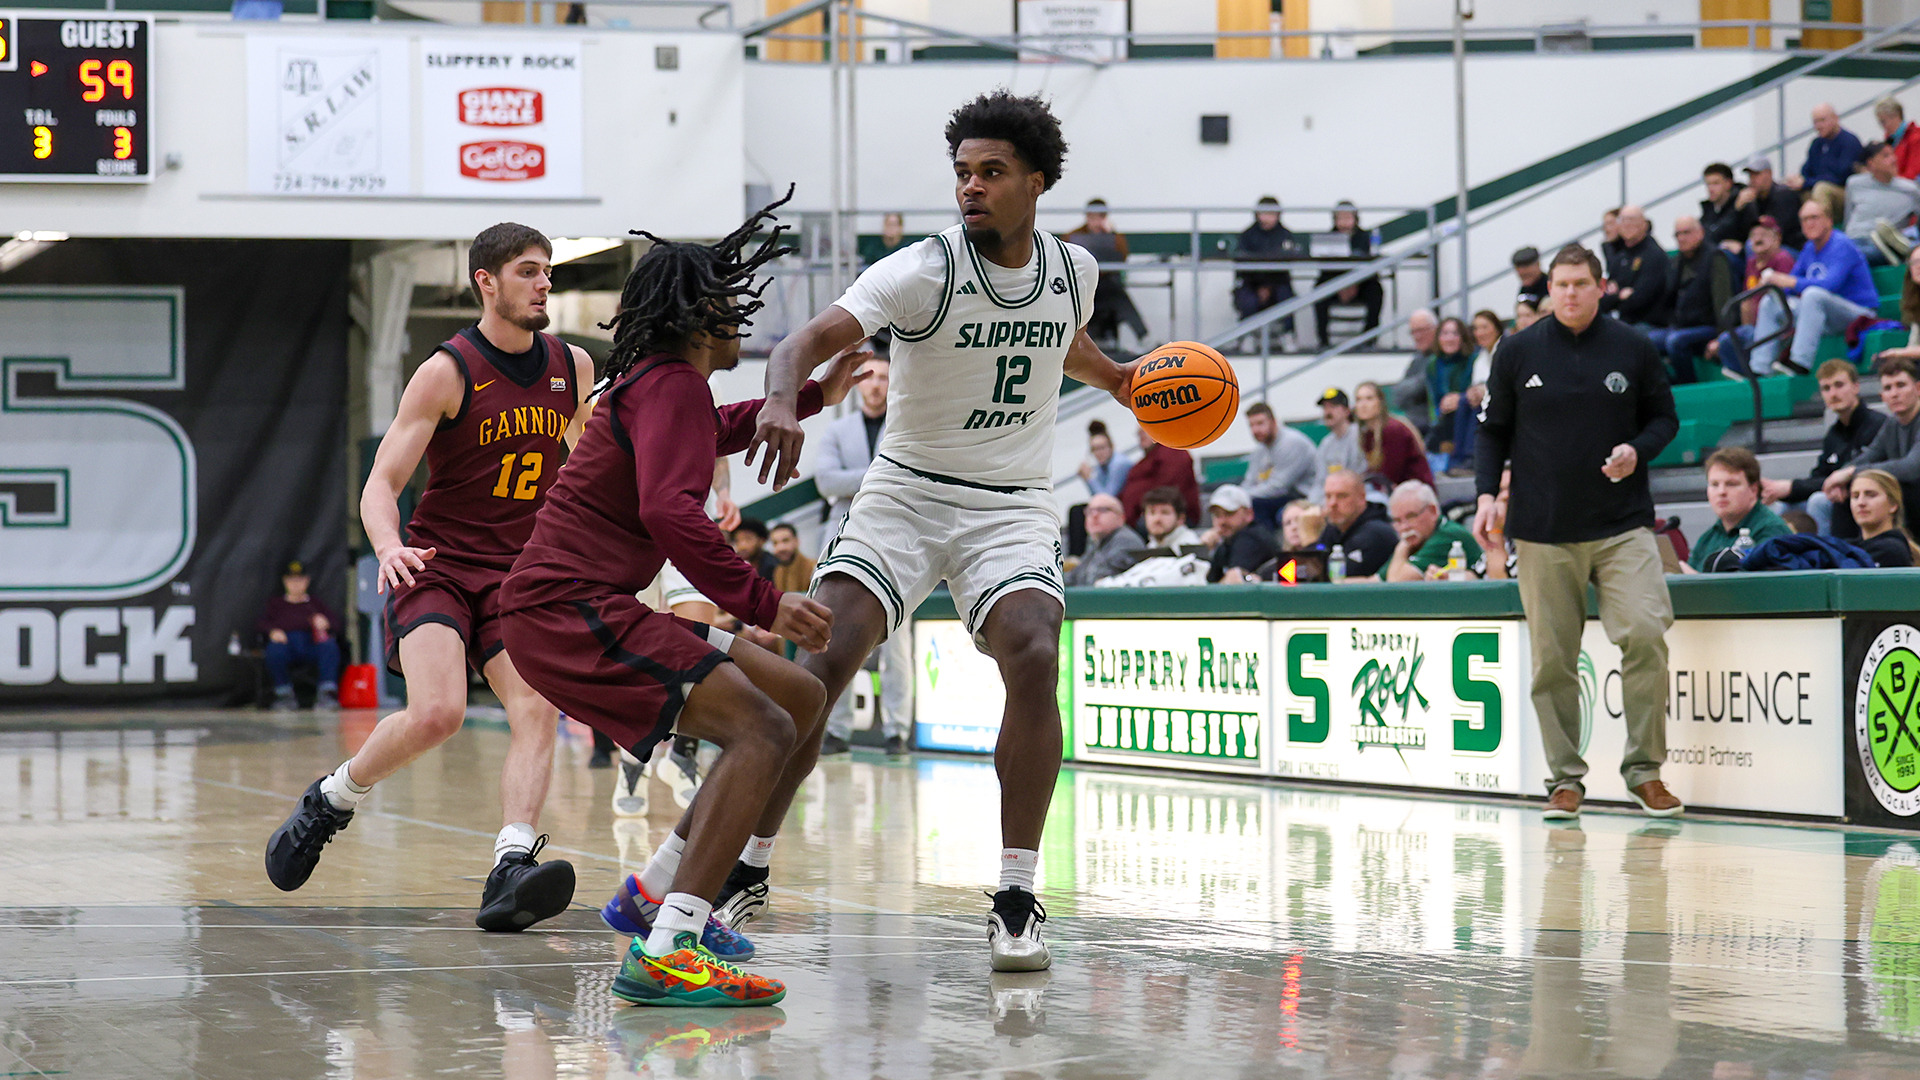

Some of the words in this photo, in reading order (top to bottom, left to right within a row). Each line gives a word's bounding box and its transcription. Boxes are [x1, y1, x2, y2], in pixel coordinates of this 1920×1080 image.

[61, 21, 139, 48] GUEST
[427, 55, 512, 70] SLIPPERY
[522, 56, 577, 70] ROCK
[79, 59, 133, 103] 59
[462, 90, 538, 109] GIANT
[464, 108, 537, 124] EAGLE
[95, 109, 137, 127] FOULS
[34, 126, 53, 160] 3
[114, 126, 132, 160] 3
[954, 321, 1067, 348] SLIPPERY
[992, 355, 1032, 404] 12
[1138, 356, 1187, 378] NCAA
[1135, 384, 1201, 409] Wilson
[0, 285, 197, 601] S
[479, 406, 569, 446] GANNON
[492, 452, 544, 500] 12
[0, 605, 198, 685] OCK
[1351, 627, 1411, 652] SLIPPERY
[1085, 635, 1187, 691] SLIPPERY
[1198, 637, 1260, 695] ROCK
[1858, 639, 1885, 715] SIGNS
[1893, 629, 1911, 644] BY
[1287, 629, 1330, 747] S
[1451, 629, 1502, 756] S
[1604, 669, 1812, 725] CFLUENCE
[1084, 705, 1259, 758] UNIVERSITY
[1666, 744, 1705, 764] nancial
[1710, 745, 1752, 767] Partners
[1895, 753, 1914, 766] SINCE
[1896, 764, 1915, 778] 1993
[1454, 771, 1470, 787] THE
[1476, 773, 1500, 788] ROCK
[1862, 745, 1880, 788] YOUR
[1880, 789, 1911, 811] LOCAL
